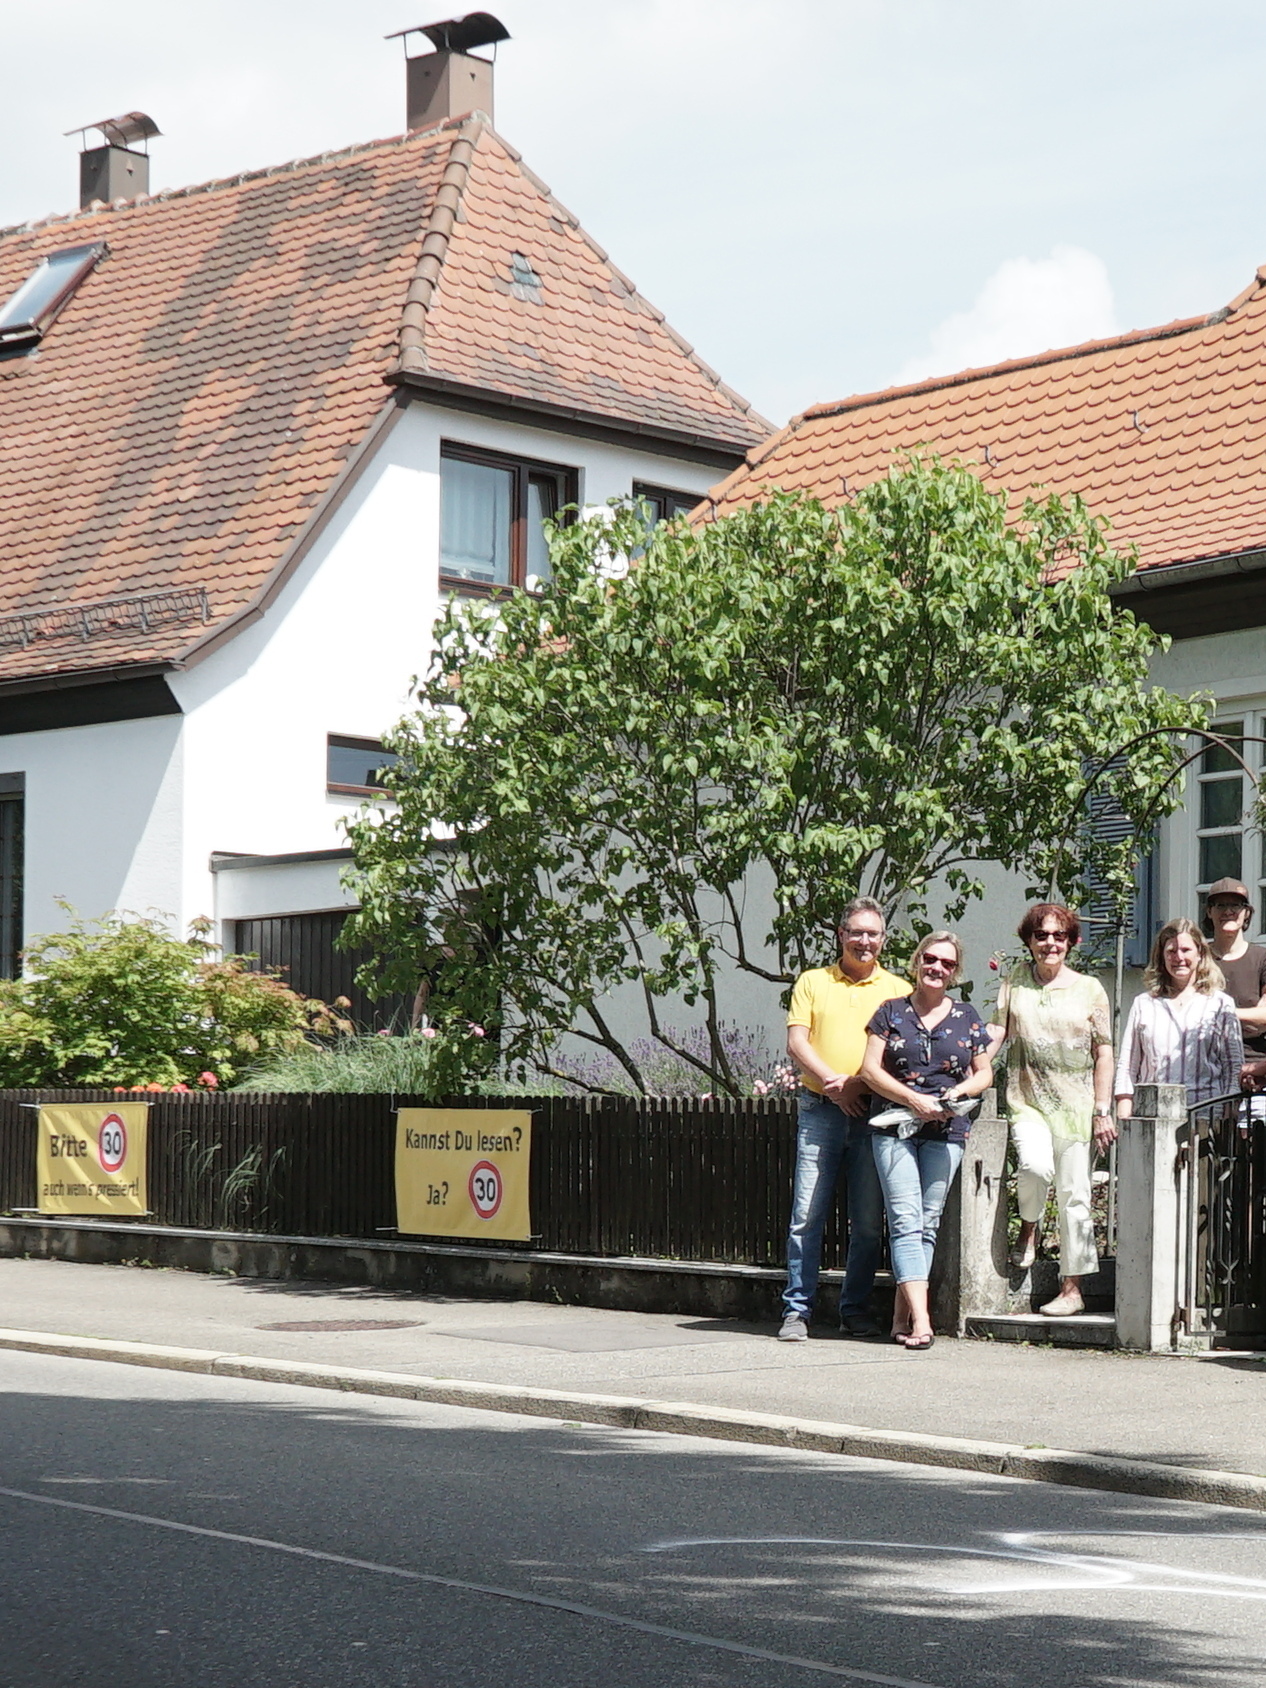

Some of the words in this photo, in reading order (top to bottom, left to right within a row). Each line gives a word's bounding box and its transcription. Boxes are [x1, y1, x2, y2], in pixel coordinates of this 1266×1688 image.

[50, 1134, 88, 1158] Bitte
[103, 1131, 122, 1155] 30
[406, 1128, 450, 1151] Kannst
[455, 1130, 472, 1151] Du
[477, 1127, 522, 1152] lesen?
[43, 1179, 65, 1197] auch
[426, 1181, 449, 1205] Ja?
[475, 1177, 497, 1202] 30
